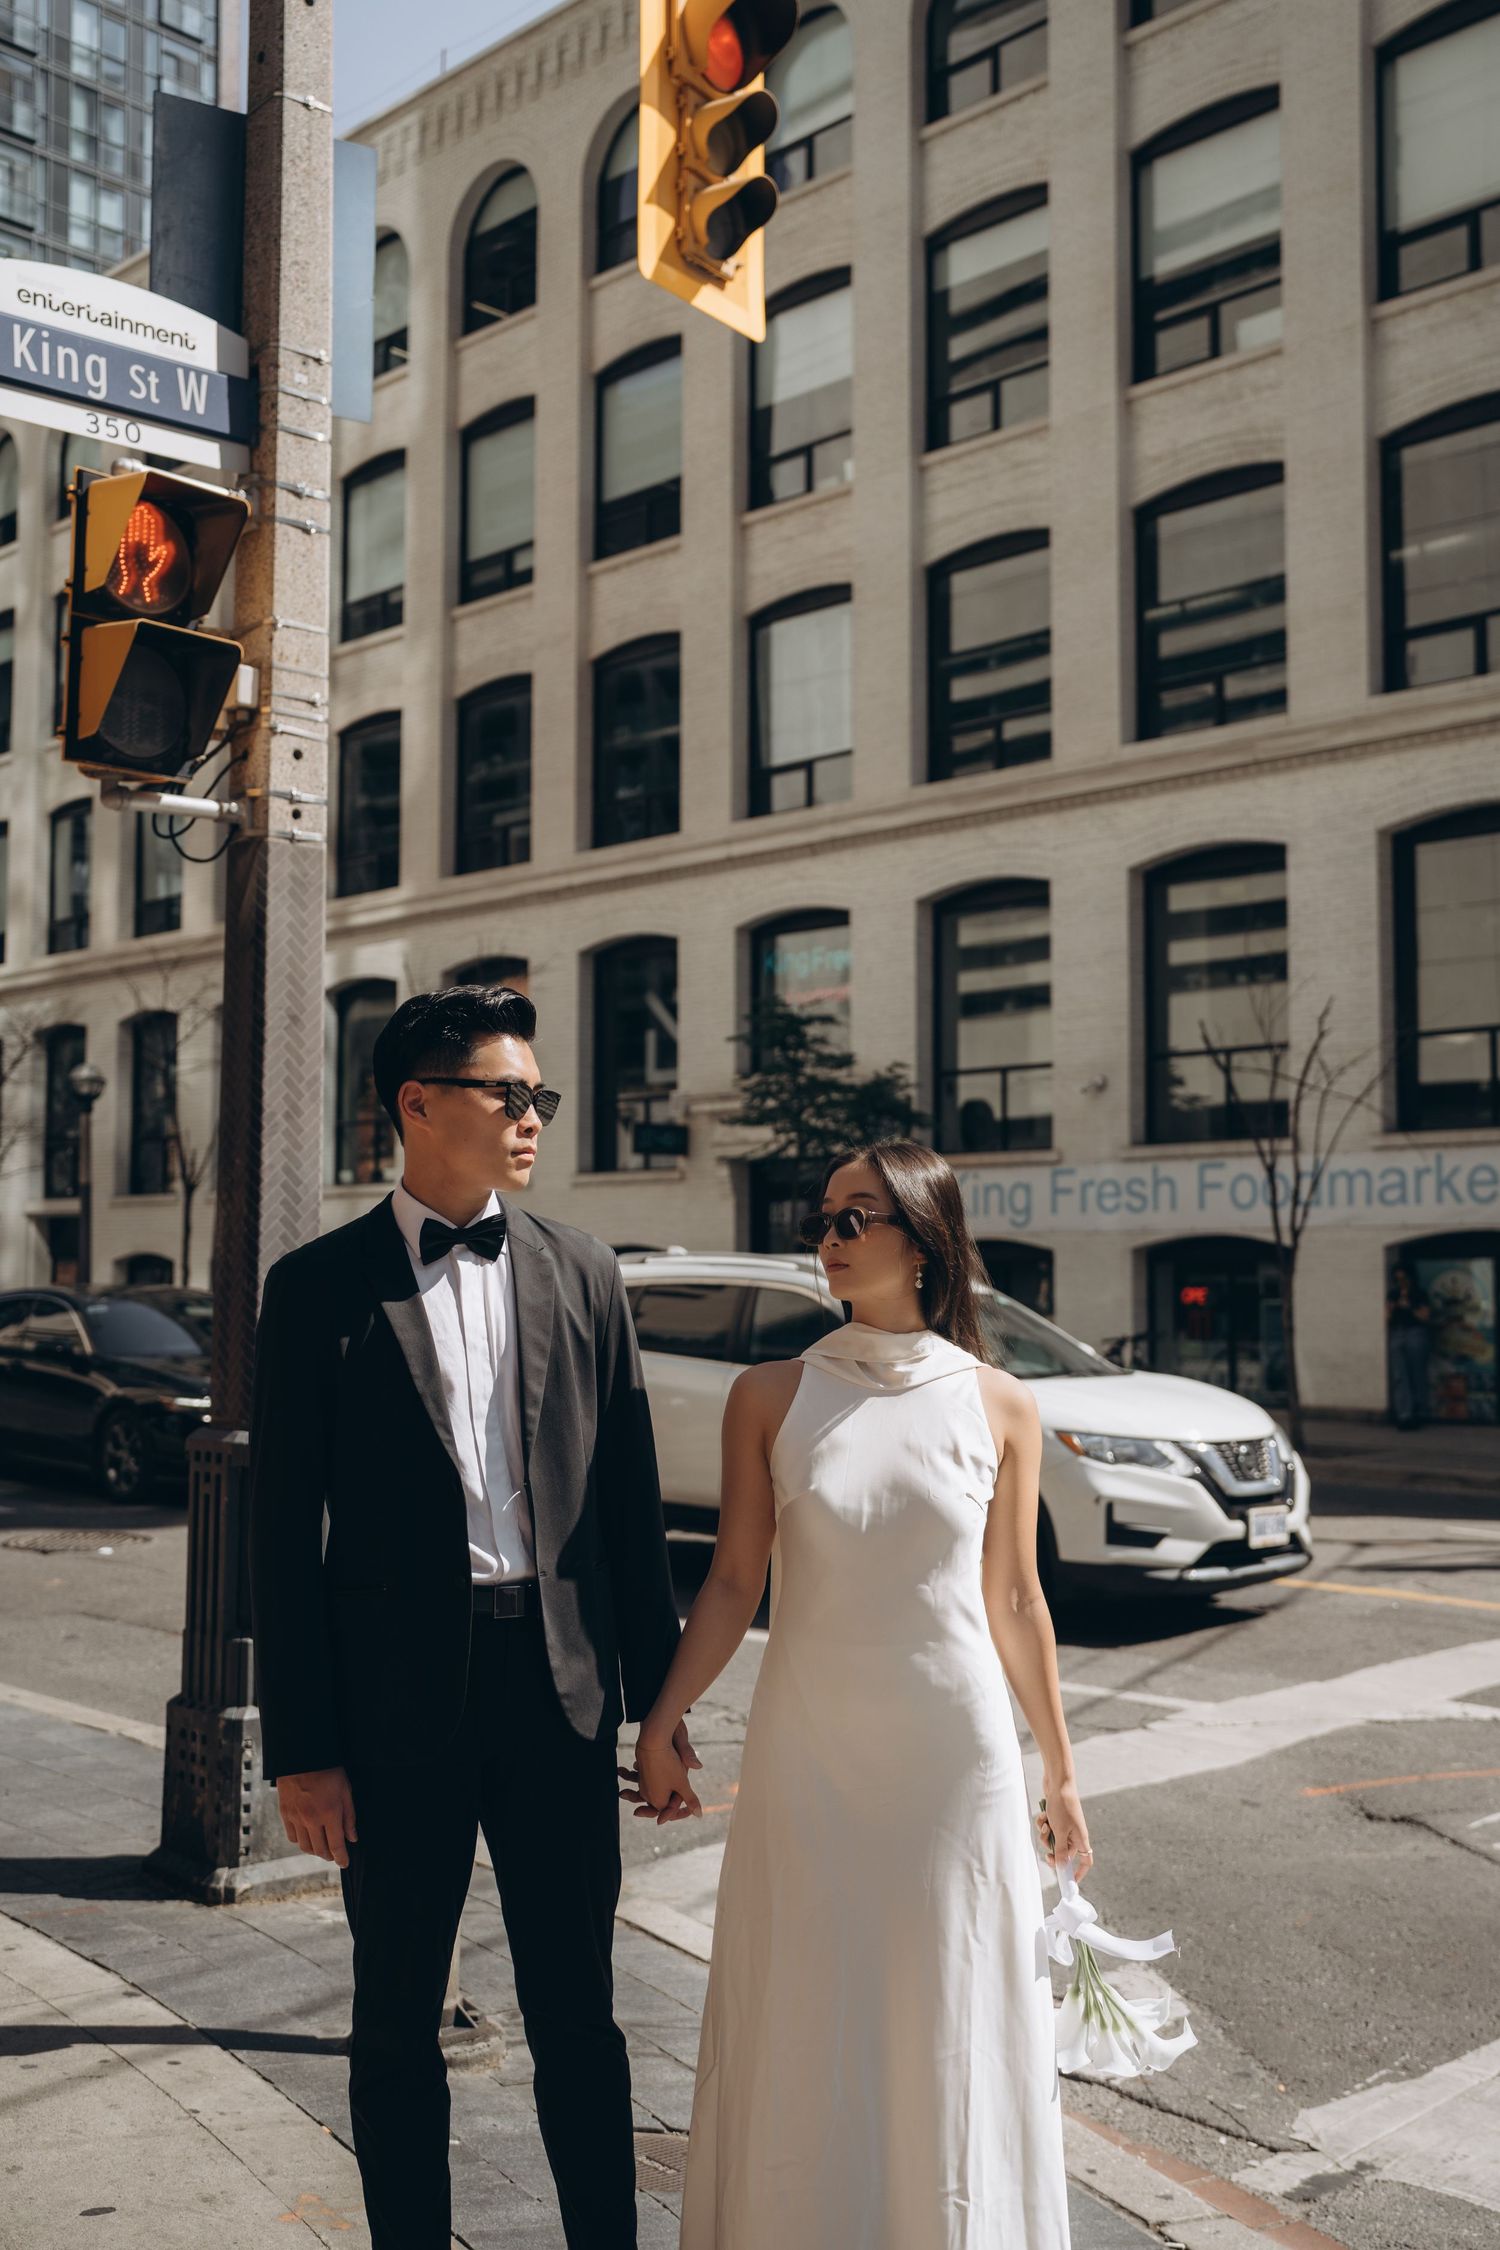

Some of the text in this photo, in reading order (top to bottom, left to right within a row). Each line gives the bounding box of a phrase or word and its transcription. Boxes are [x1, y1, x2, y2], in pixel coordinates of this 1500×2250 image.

[12, 323, 209, 416] King St W
[86, 412, 142, 444] 350
[1050, 1165, 1178, 1215] Fresh
[1196, 1152, 1500, 1212] Foodmarke
